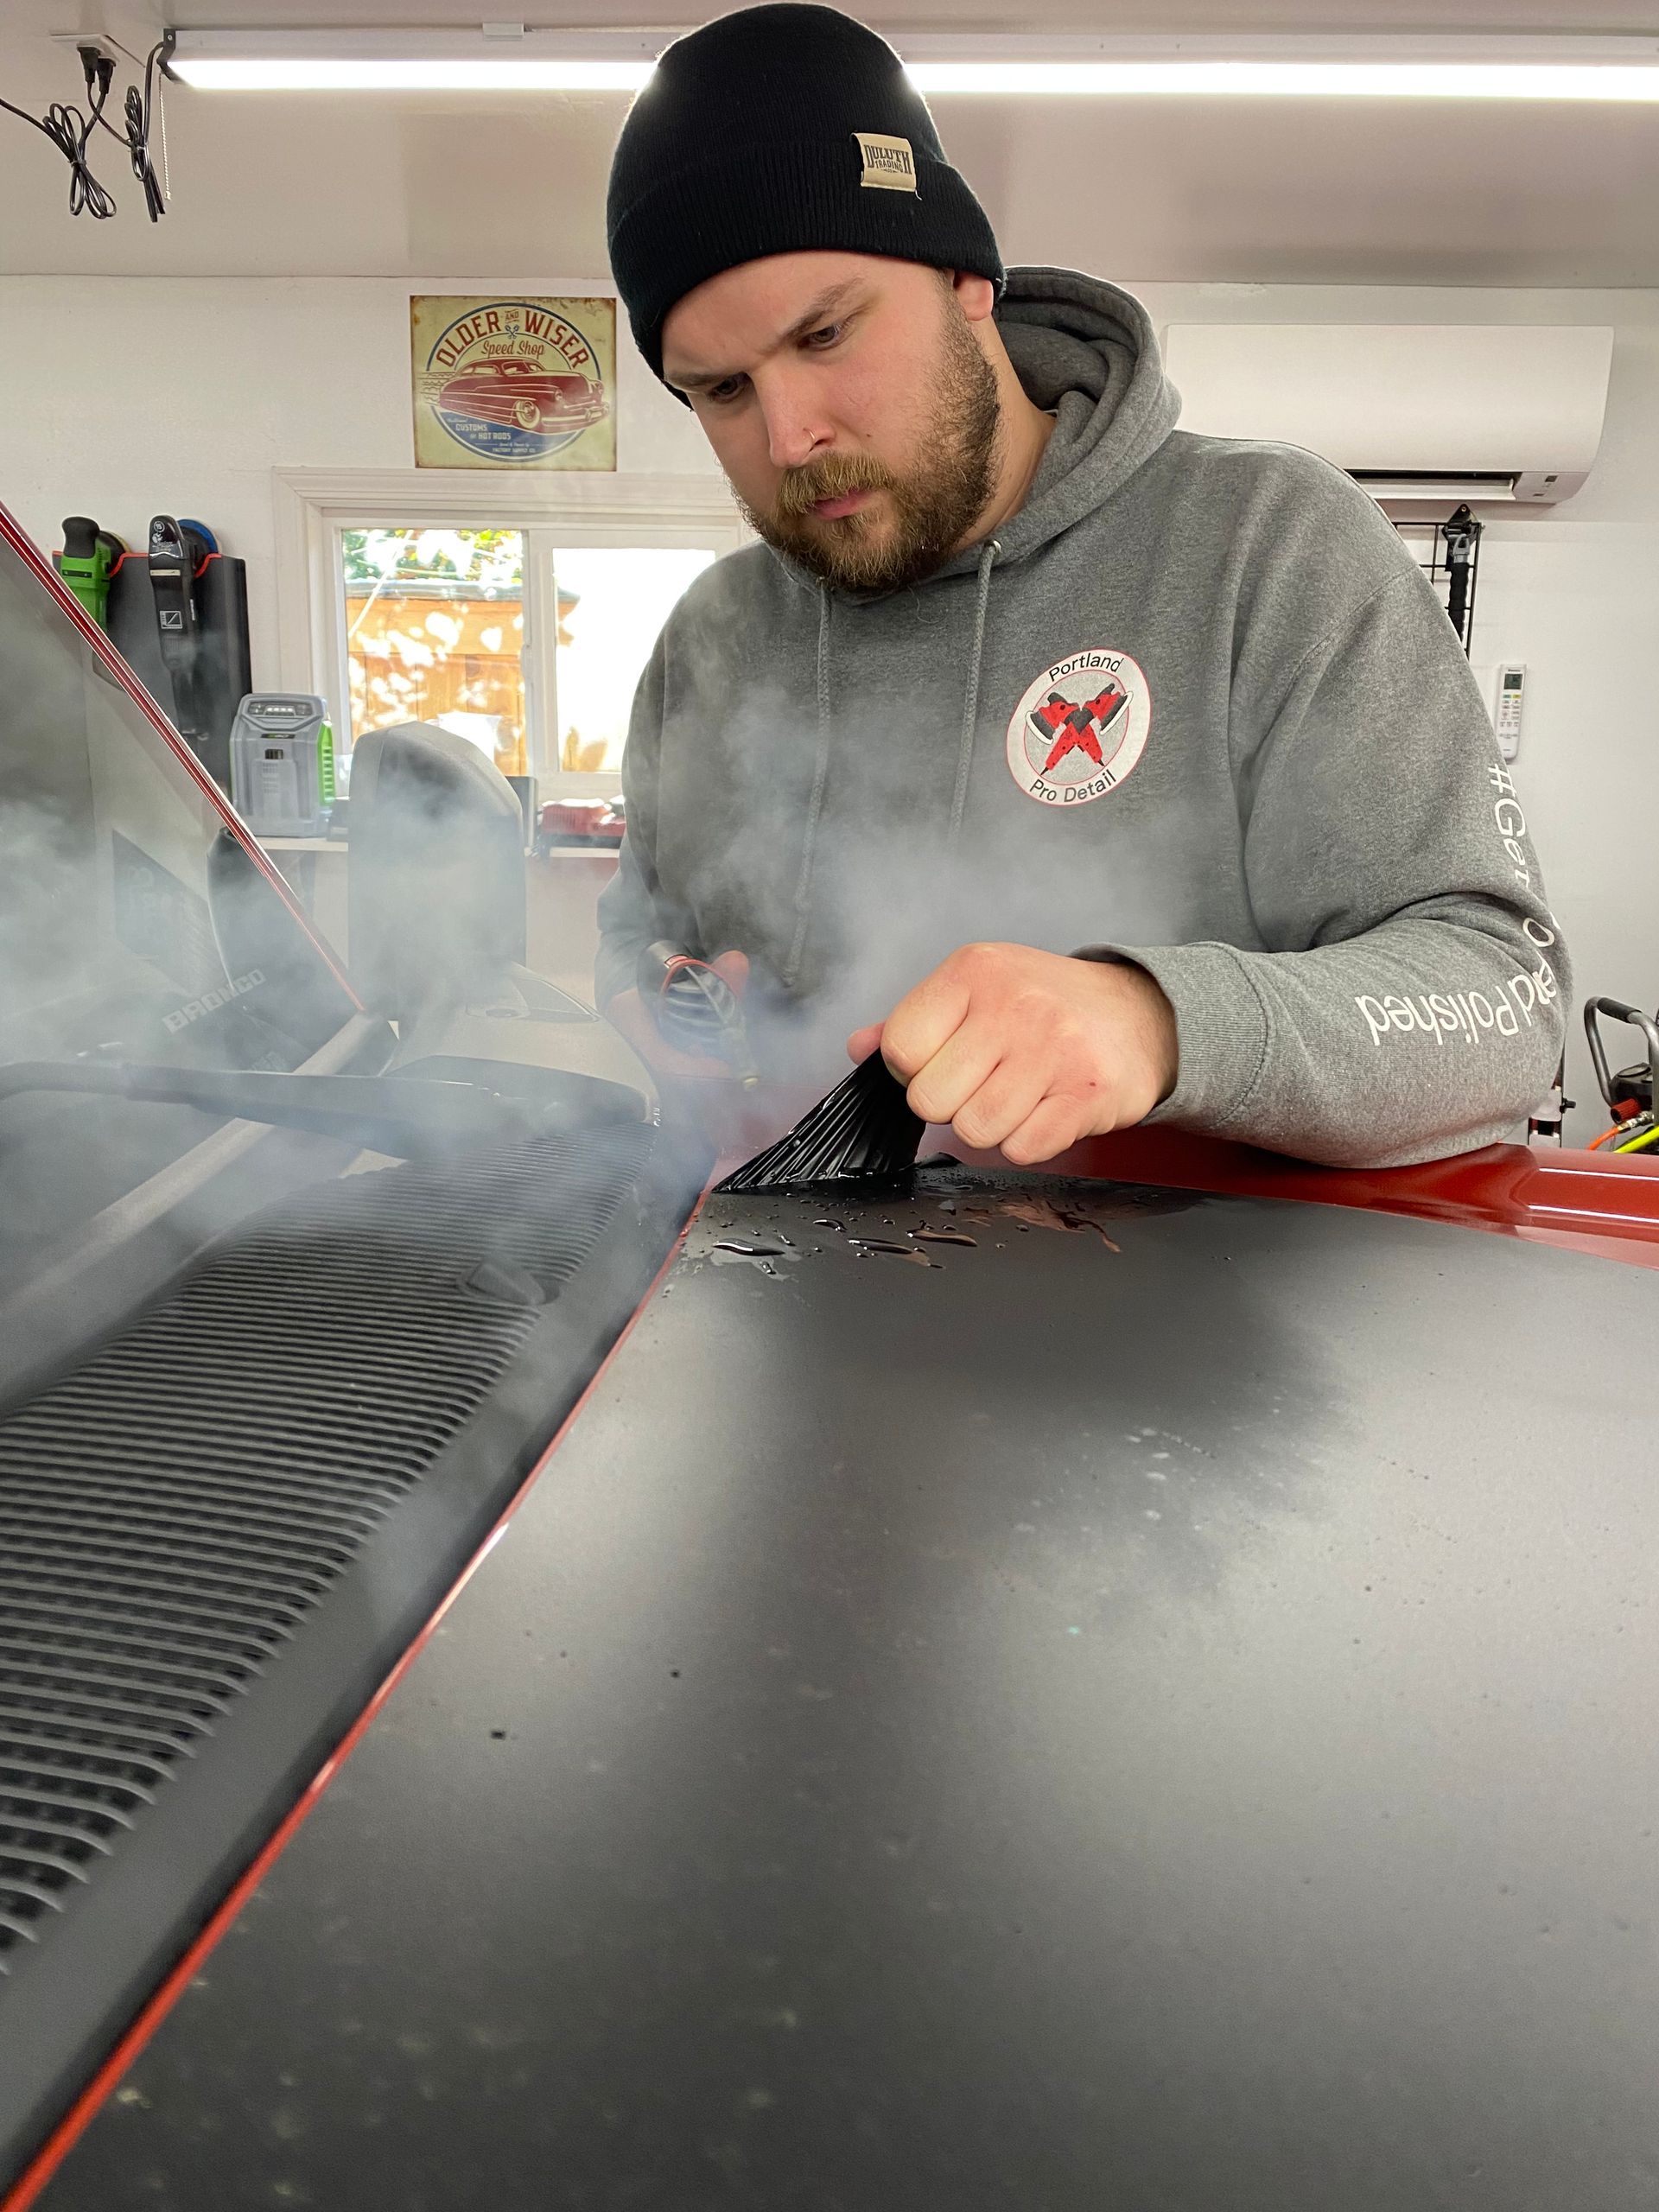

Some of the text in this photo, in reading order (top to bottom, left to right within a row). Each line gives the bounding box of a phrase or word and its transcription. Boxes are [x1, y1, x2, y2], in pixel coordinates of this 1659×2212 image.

[864, 144, 912, 175] DULUTH
[874, 159, 904, 173] TRADING
[435, 310, 502, 368] OLDER
[524, 309, 589, 369] WISER
[481, 340, 545, 359] Speed Shop
[1048, 652, 1125, 683] Portland
[1029, 769, 1117, 803] Pro Detail
[162, 969, 267, 1034] BRONCO
